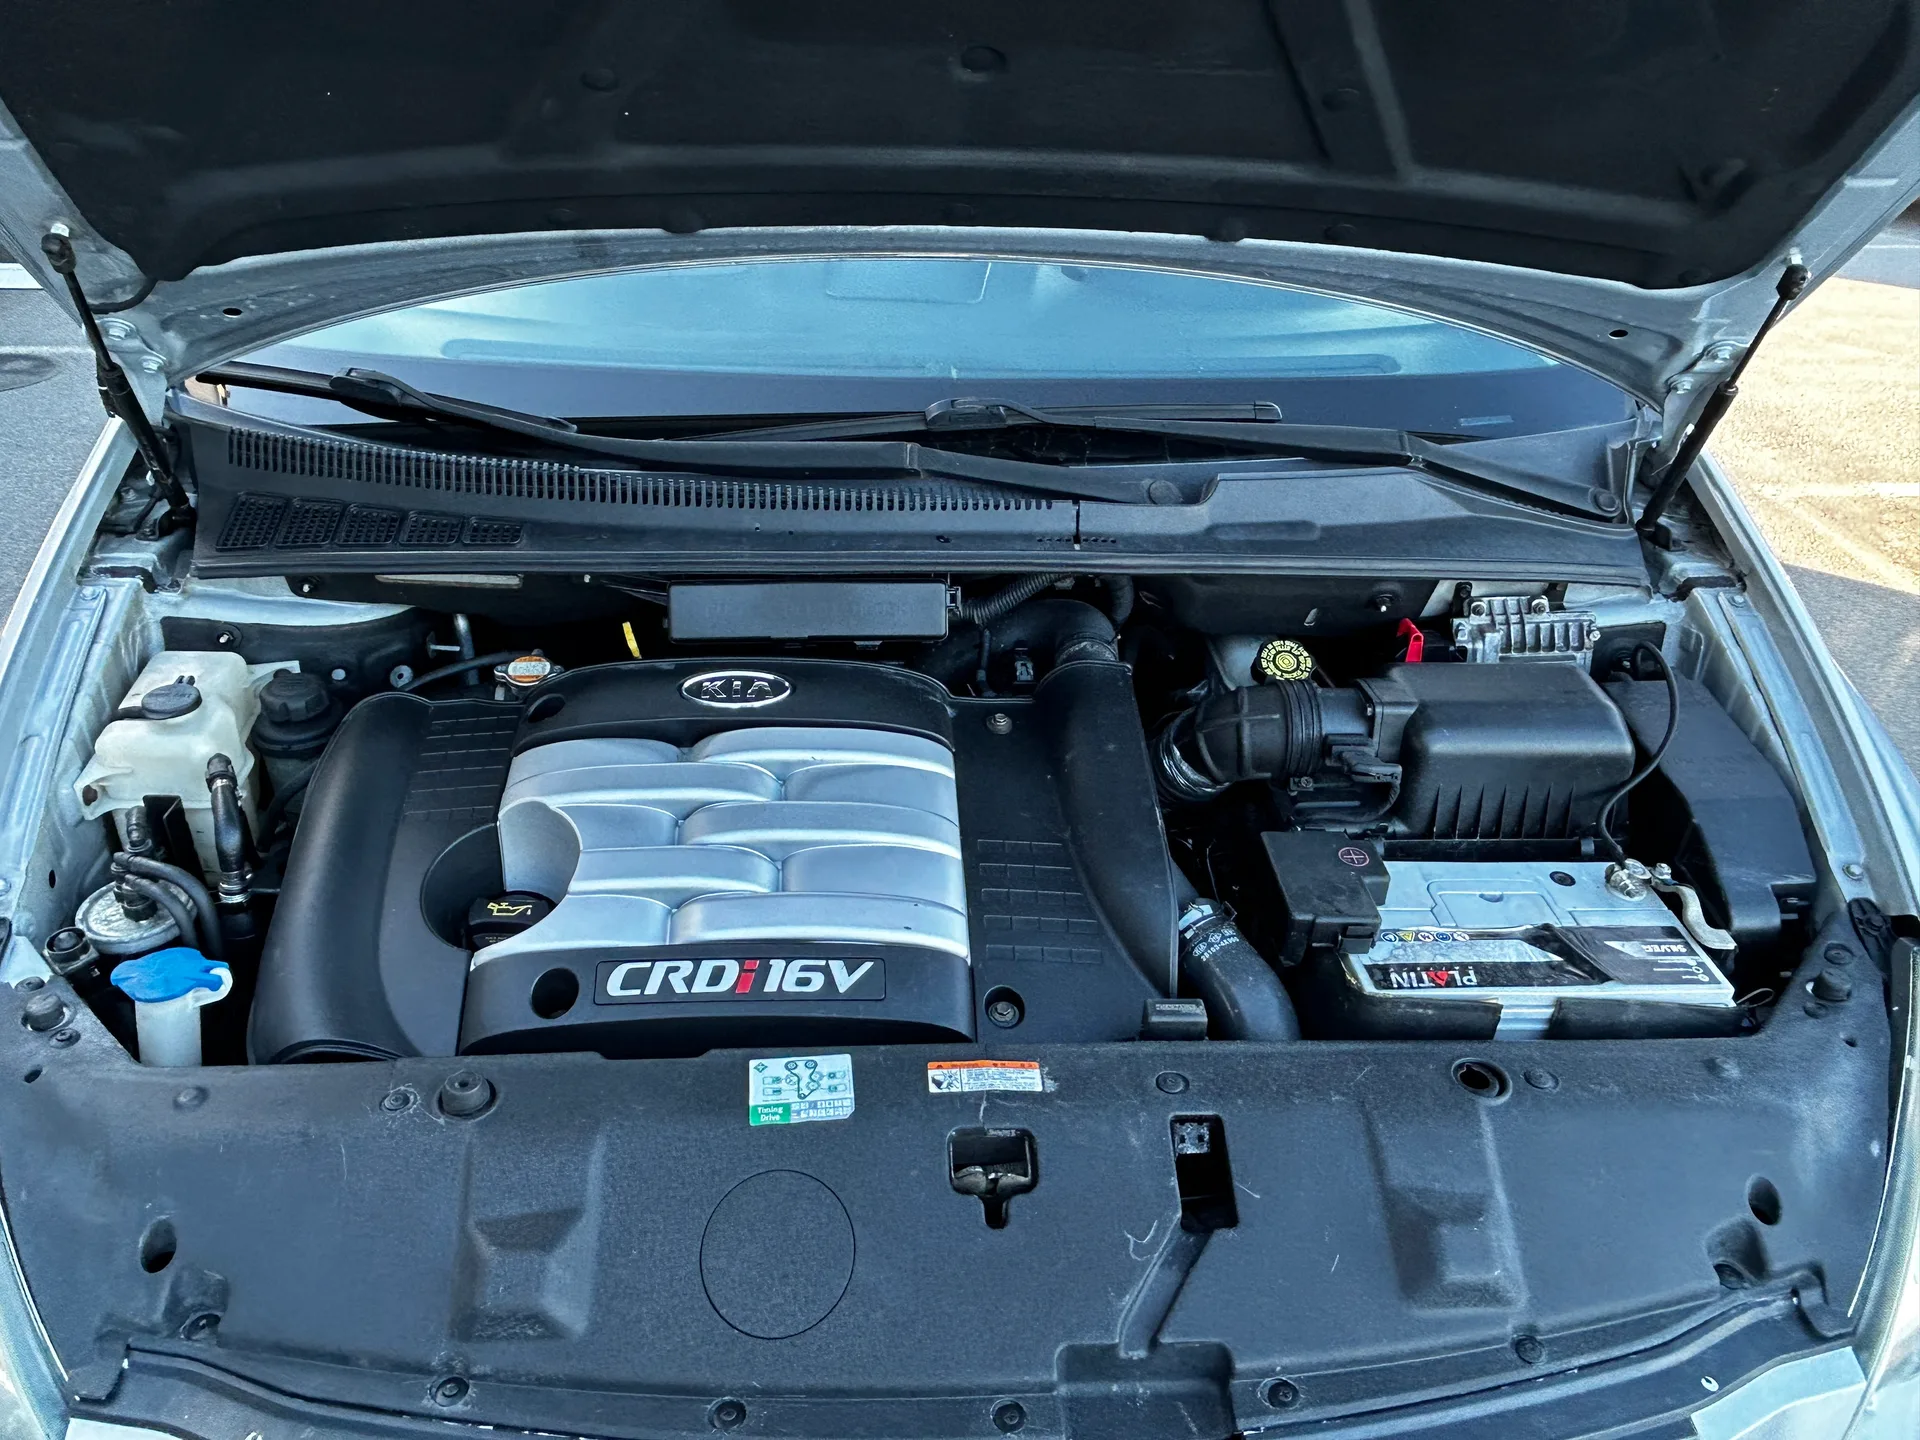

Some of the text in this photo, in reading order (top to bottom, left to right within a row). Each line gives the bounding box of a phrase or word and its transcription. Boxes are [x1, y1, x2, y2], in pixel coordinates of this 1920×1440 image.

[700, 679, 774, 699] KIA
[1641, 944, 1687, 953] SILVER
[1389, 969, 1478, 988] PLATIN
[757, 1106, 784, 1114] Timing
[760, 1114, 781, 1122] Drive
